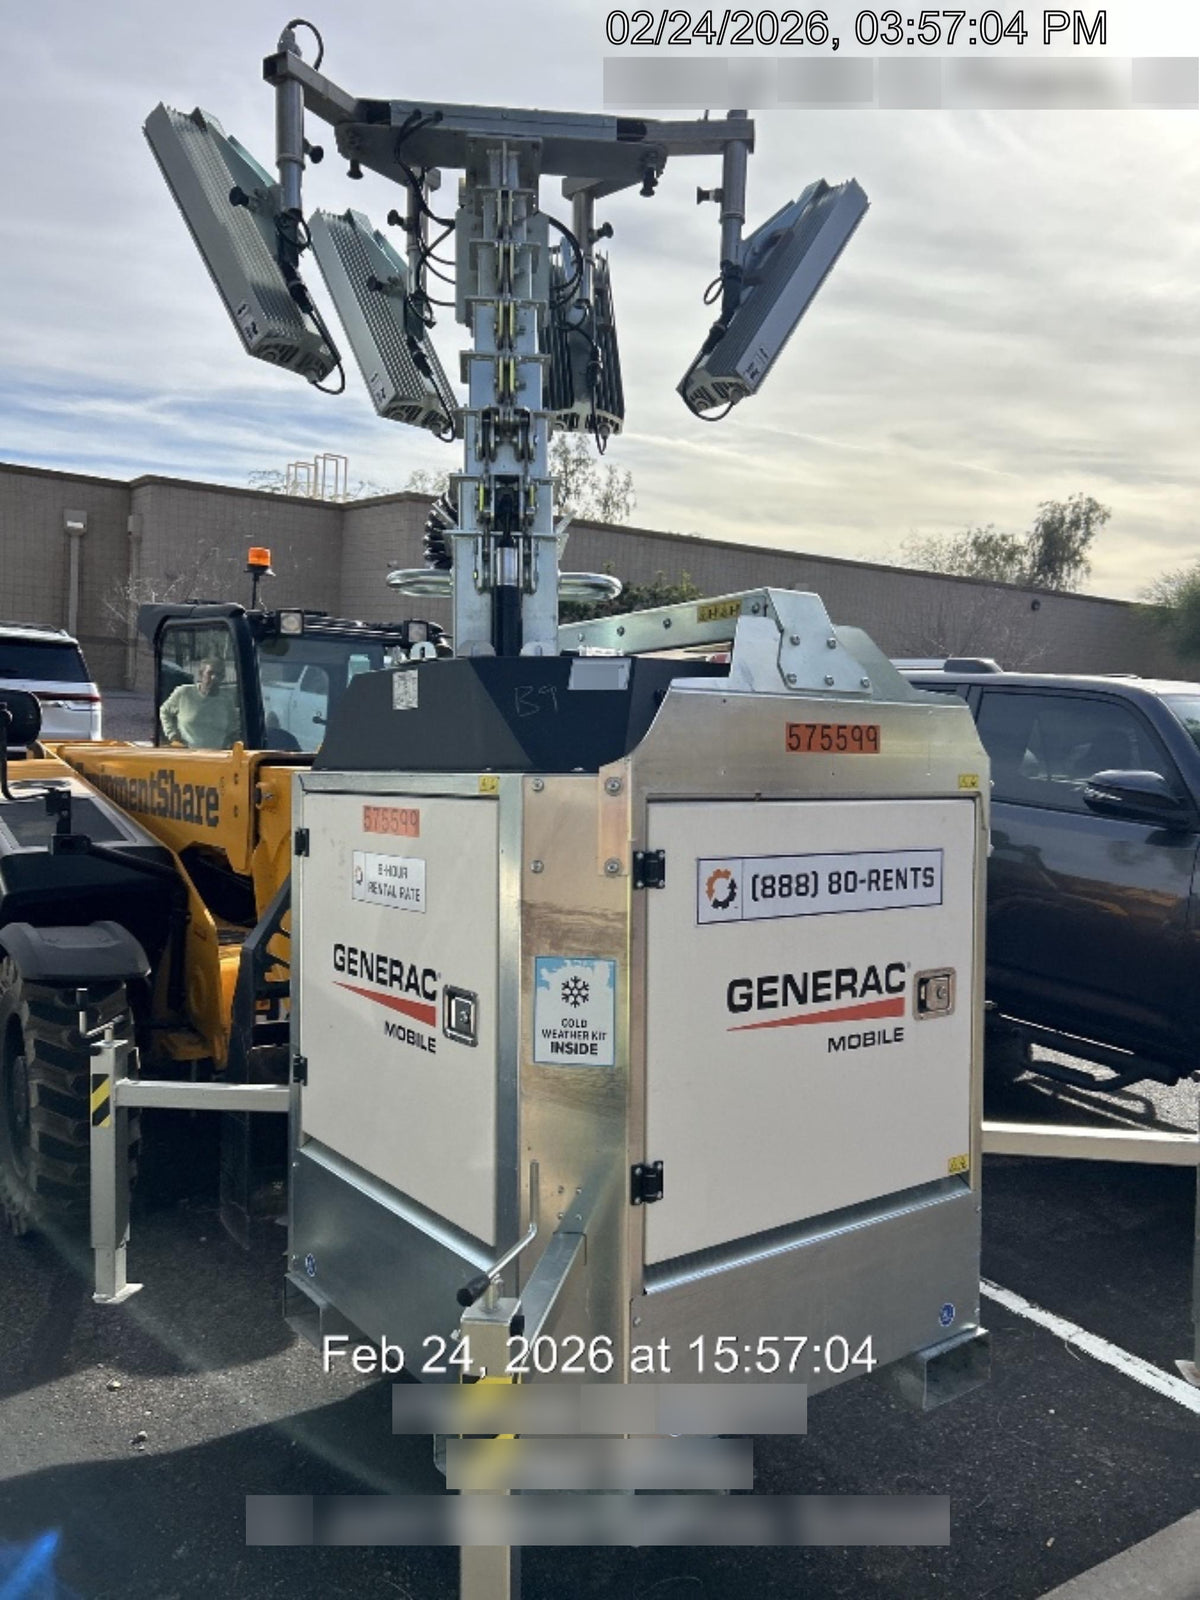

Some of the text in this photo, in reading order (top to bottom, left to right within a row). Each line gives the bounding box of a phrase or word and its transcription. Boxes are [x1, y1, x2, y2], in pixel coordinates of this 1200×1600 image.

[787, 724, 878, 751] 575599
[367, 881, 421, 903] RENTAL RATE
[751, 866, 935, 902] (888) 80-RENTS
[333, 943, 438, 1002] GENERAC
[726, 961, 906, 1014] GENERAC
[541, 1028, 608, 1041] WEATHER KIT
[561, 1018, 588, 1029] COLD
[384, 1020, 437, 1054] MOBILE
[550, 1041, 599, 1056] INSIDE
[827, 1027, 905, 1053] MOBILE
